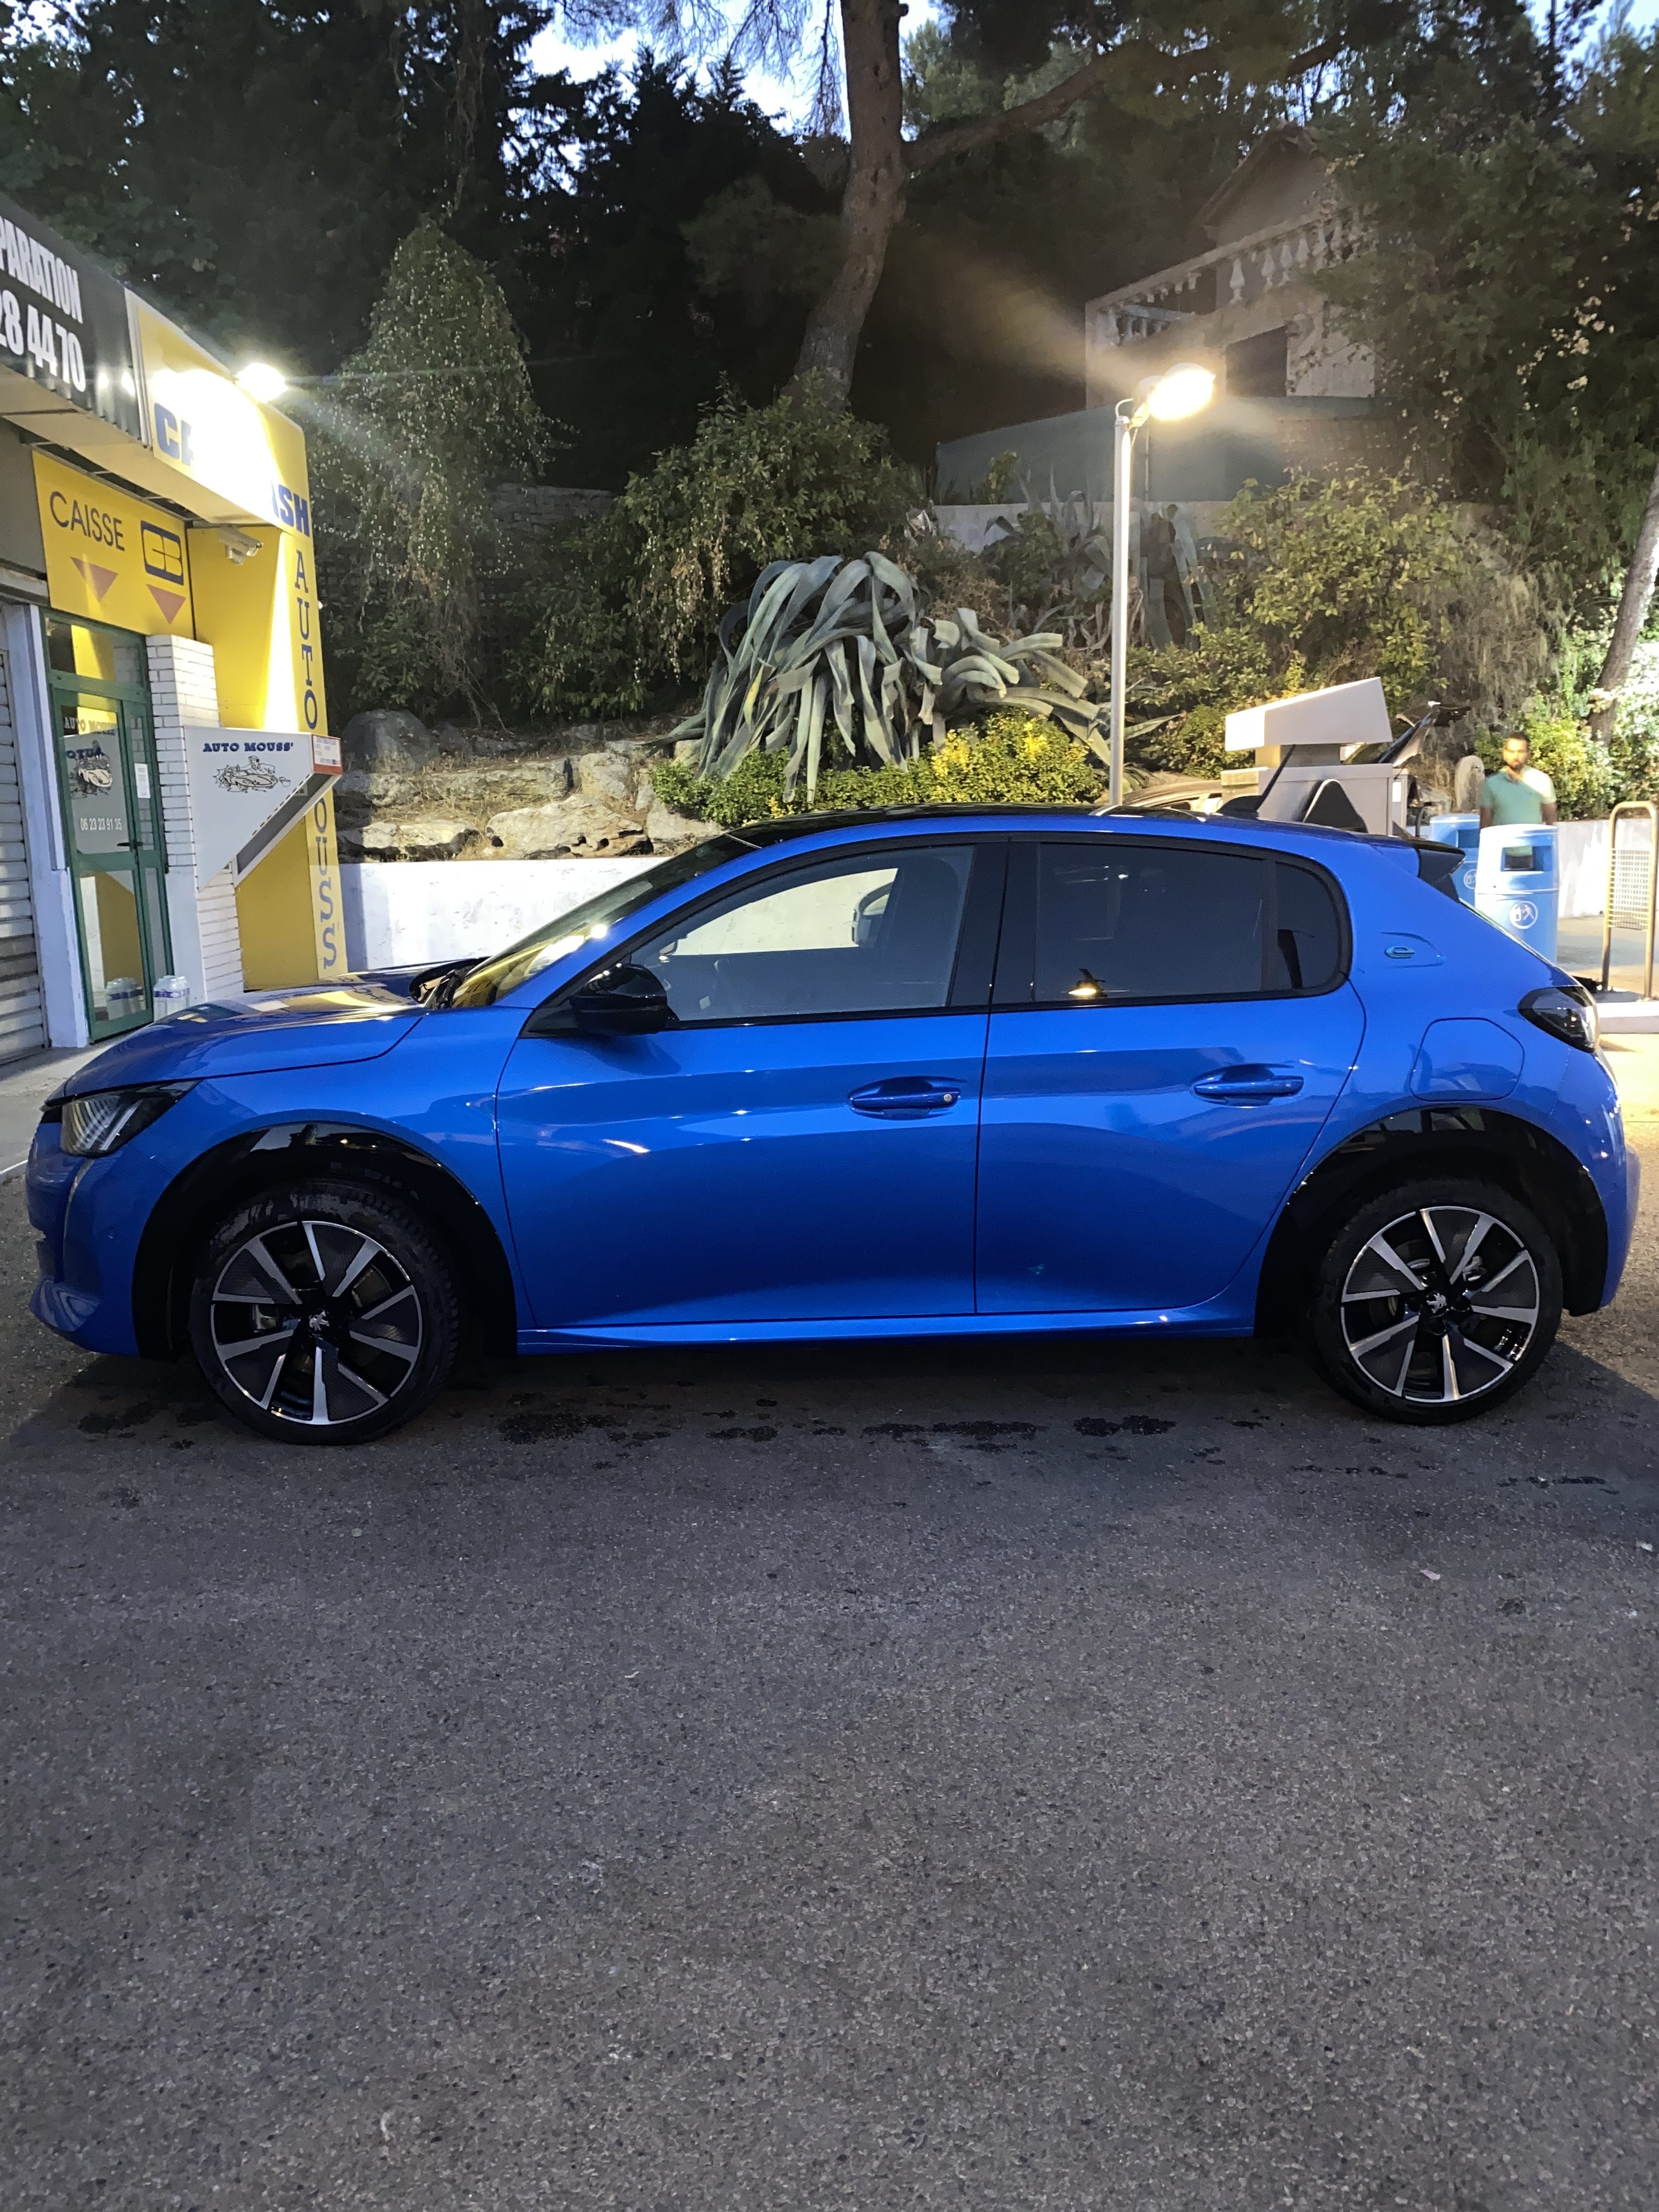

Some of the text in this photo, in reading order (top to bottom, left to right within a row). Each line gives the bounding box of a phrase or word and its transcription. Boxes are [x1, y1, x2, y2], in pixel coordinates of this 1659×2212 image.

[50, 491, 125, 551] CAISSE
[295, 549, 318, 730] AUTO
[202, 742, 294, 752] AUTO MOUSS'
[80, 817, 88, 831] 06
[89, 817, 97, 831] 23
[98, 817, 105, 831] 23
